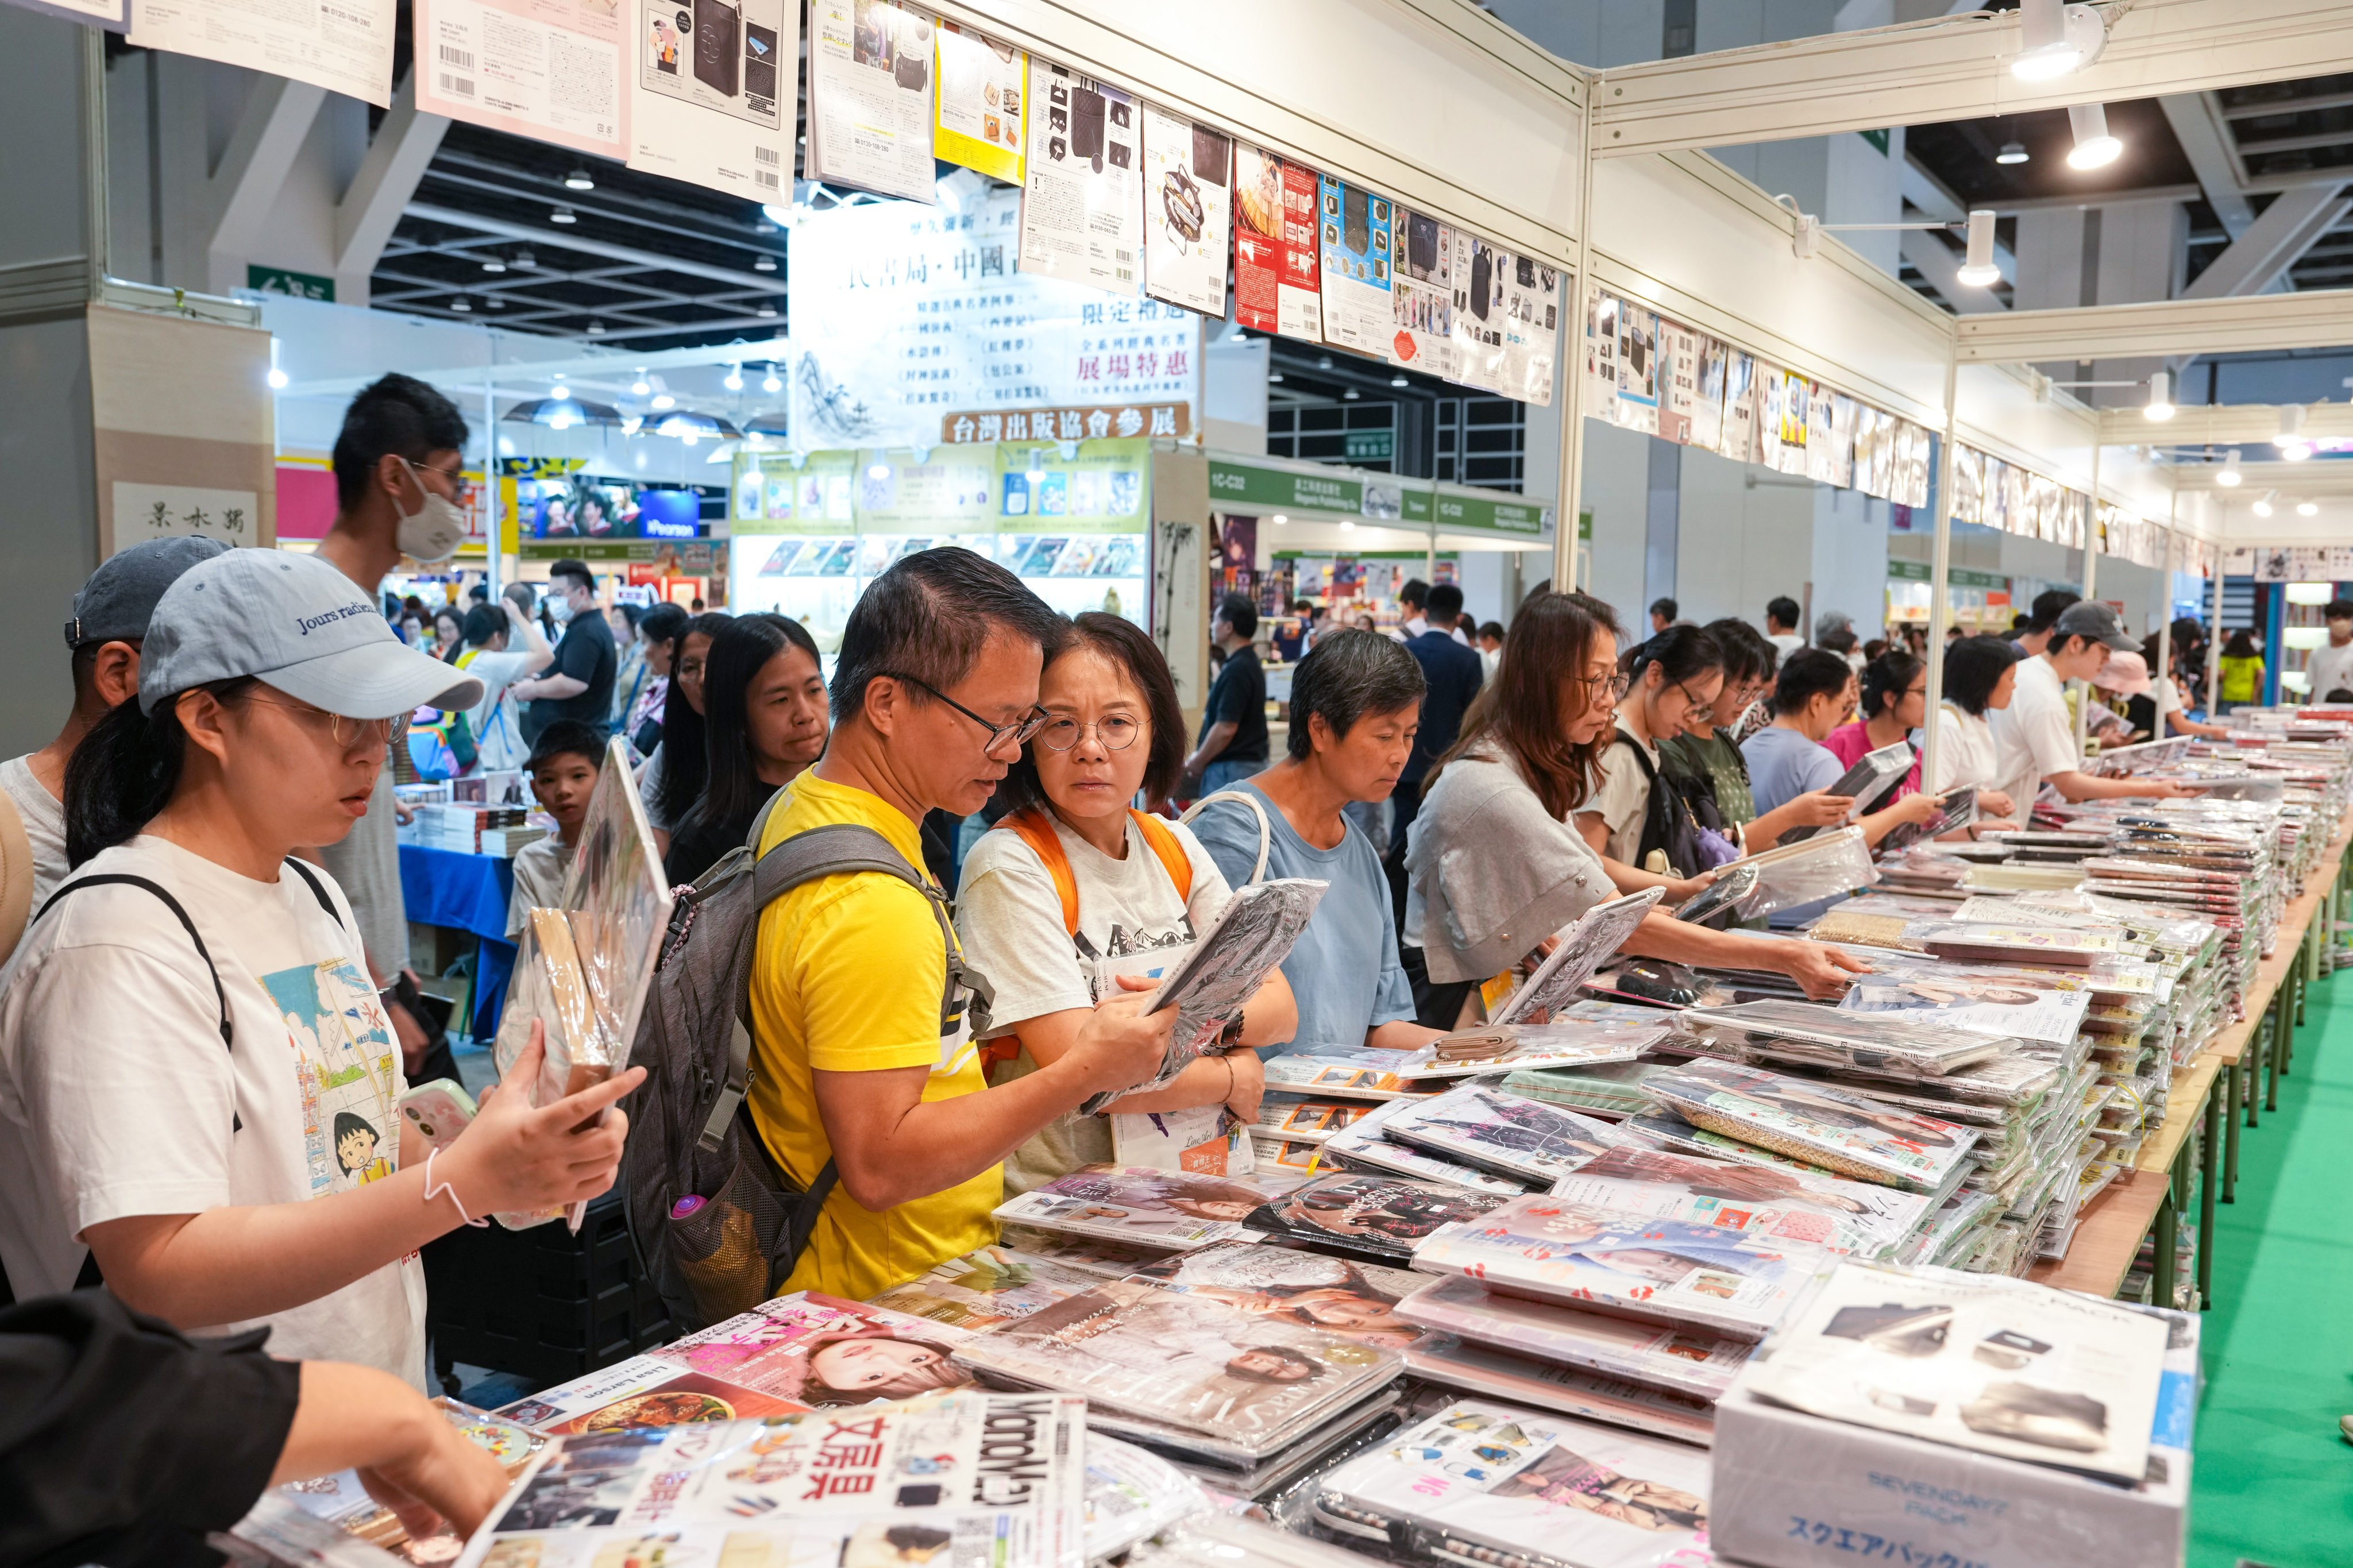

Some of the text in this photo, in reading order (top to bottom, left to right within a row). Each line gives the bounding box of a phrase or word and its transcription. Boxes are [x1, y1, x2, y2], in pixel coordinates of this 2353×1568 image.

[861, 139, 889, 152] 0120-108-280
[1077, 350, 1188, 380] 展場特惠
[952, 405, 1178, 443] 台灣出版協會參展
[653, 519, 694, 537] Pearson
[296, 610, 339, 636] Jours
[1221, 897, 1236, 915] リンネル
[1862, 1045, 1890, 1054] オトナミューズ
[1900, 1051, 1930, 1061] otonaMUSE
[1185, 1130, 1214, 1148] Line Art
[1905, 1172, 1924, 1183] inRed
[1379, 1248, 1399, 1256] DRAMATIC
[636, 1364, 669, 1384] Lisa
[584, 1376, 635, 1400] Larson
[801, 1416, 892, 1501] 文房具
